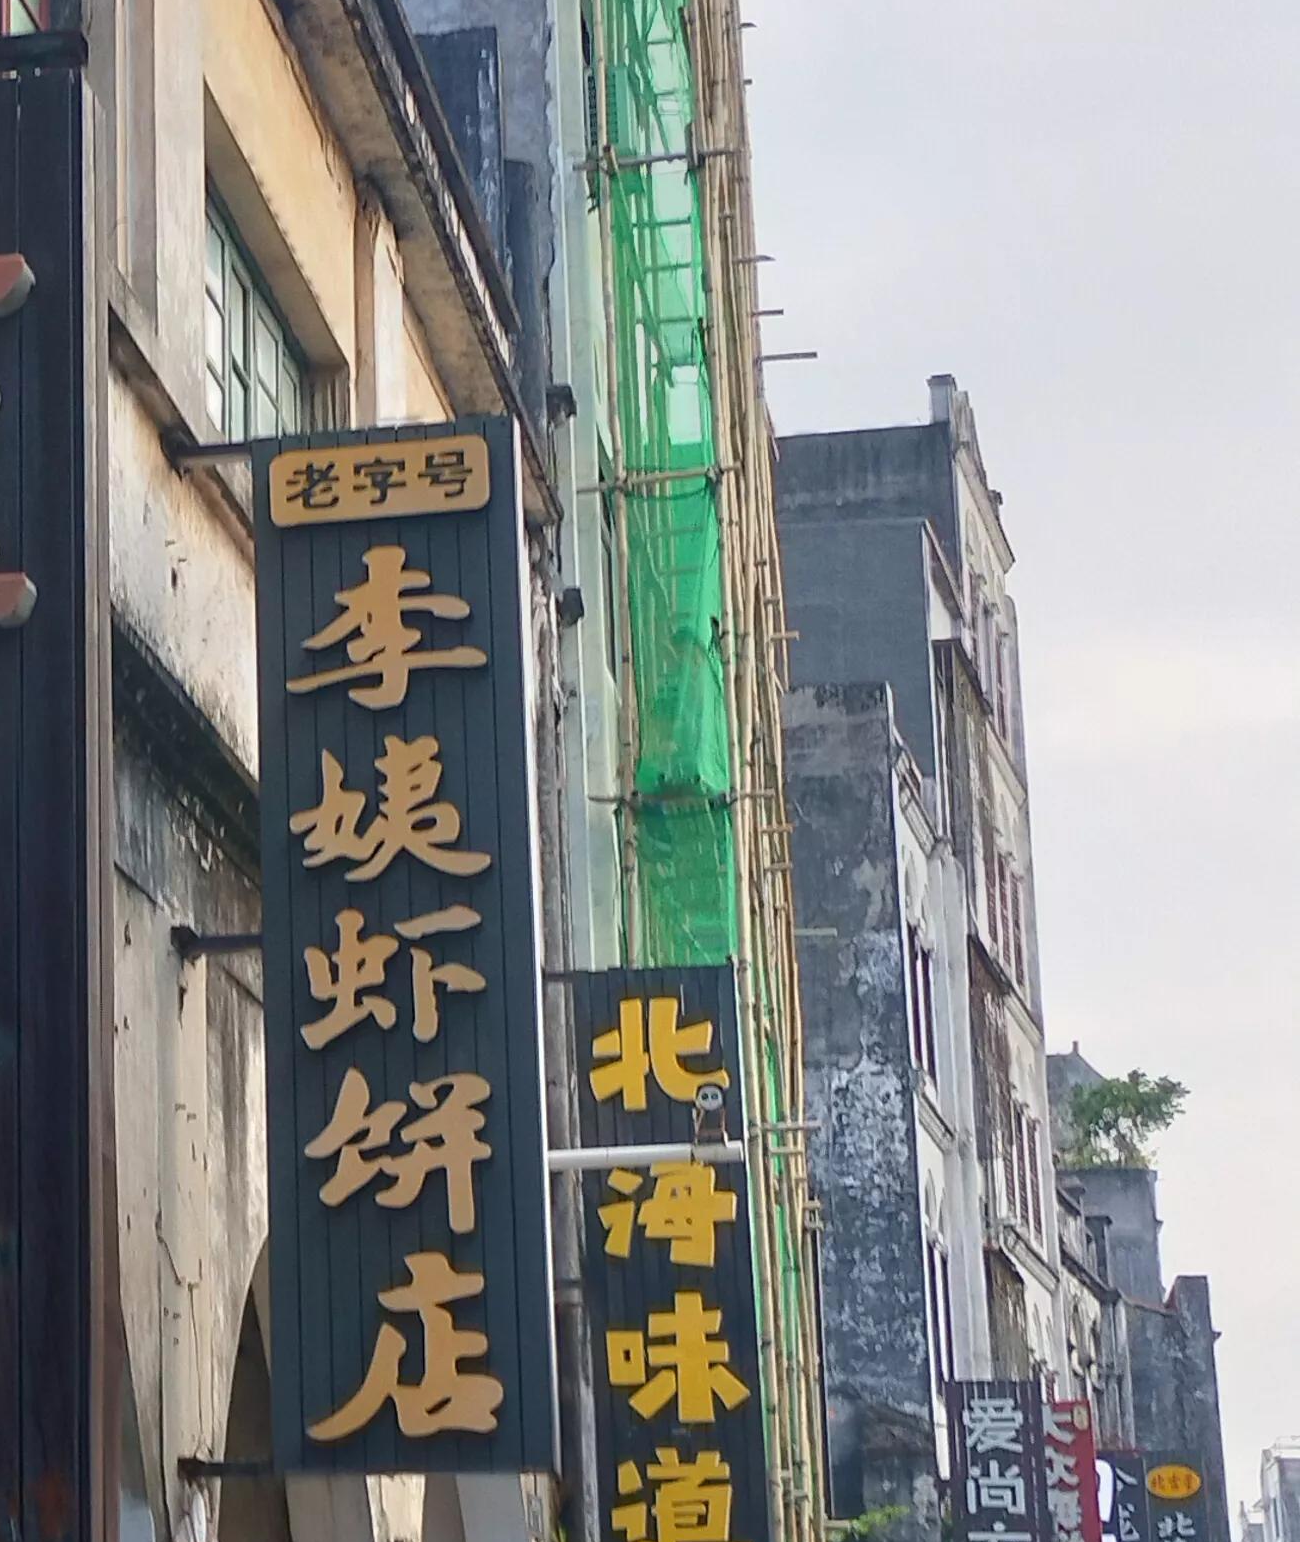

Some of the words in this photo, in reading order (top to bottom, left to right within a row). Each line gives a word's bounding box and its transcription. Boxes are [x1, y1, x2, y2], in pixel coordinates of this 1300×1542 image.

[285, 439, 477, 509] 老字号
[285, 543, 504, 1445] 李姨虾饼店
